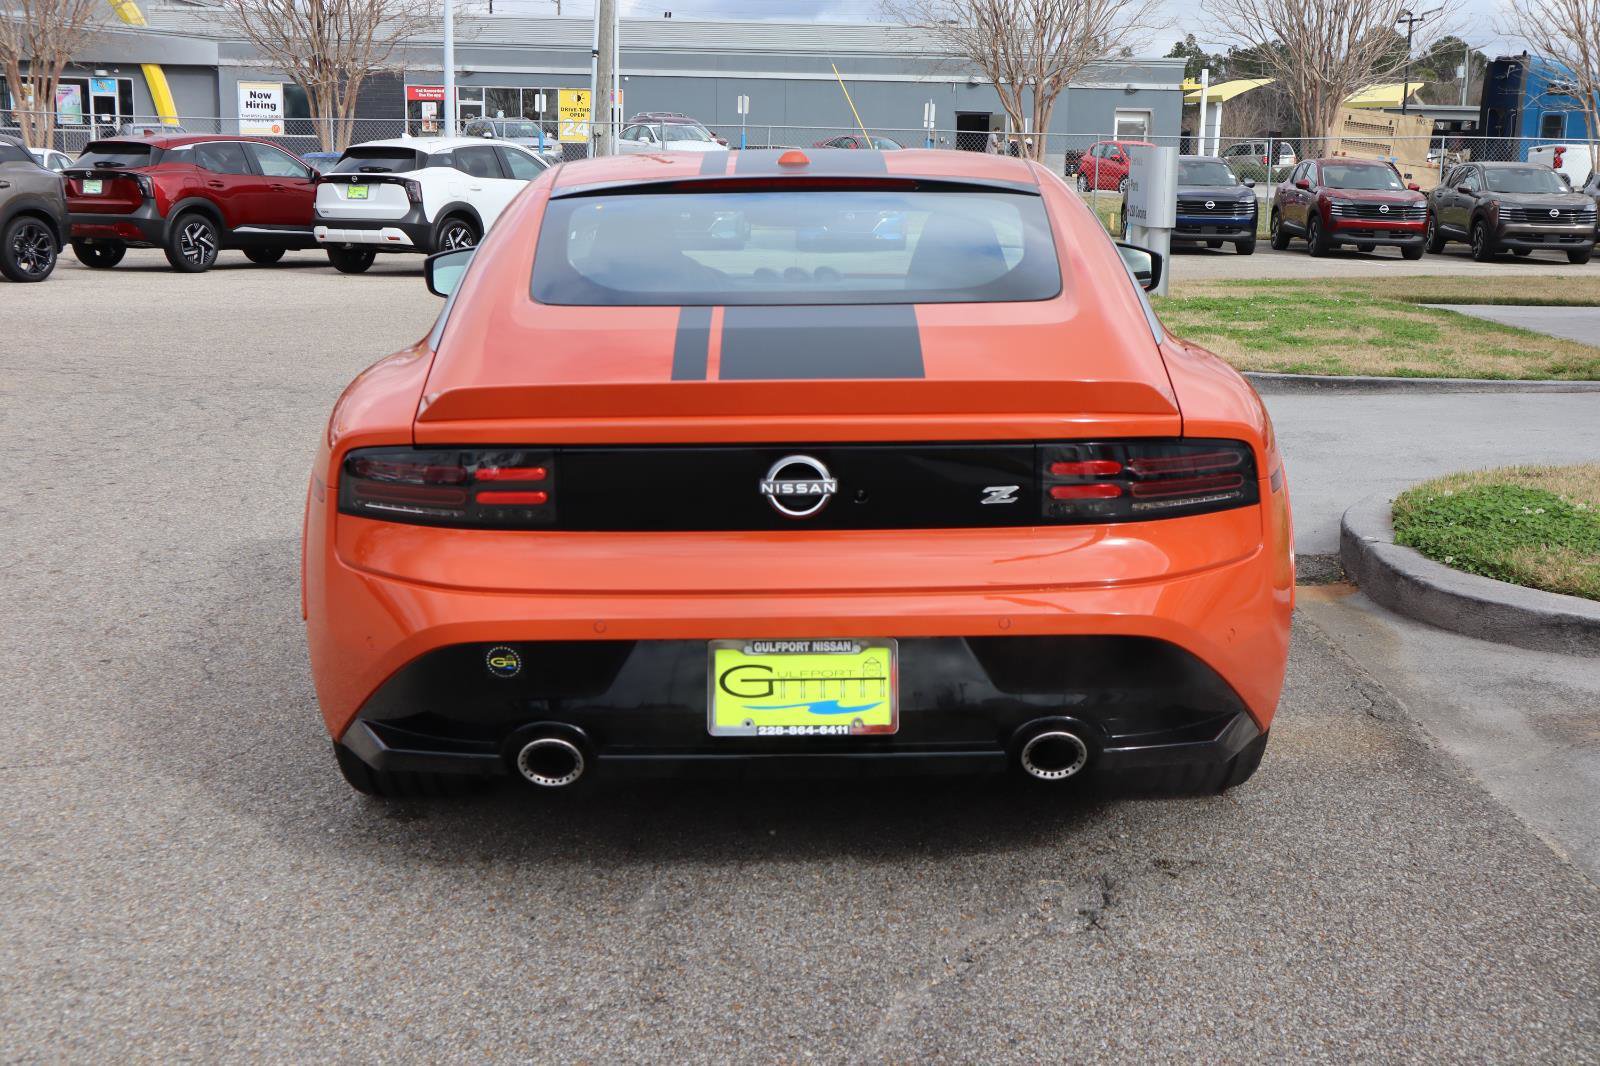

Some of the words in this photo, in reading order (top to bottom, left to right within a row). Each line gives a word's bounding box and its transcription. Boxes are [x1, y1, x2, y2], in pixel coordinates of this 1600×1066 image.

[249, 90, 272, 99] Now
[245, 100, 277, 111] Hiring
[562, 118, 590, 137] 24
[761, 482, 837, 495] NISSAN
[980, 485, 1020, 505] Z
[754, 641, 810, 653] GULFPORT
[812, 641, 851, 652] NISSAN
[758, 725, 849, 736] 228-864-6411
